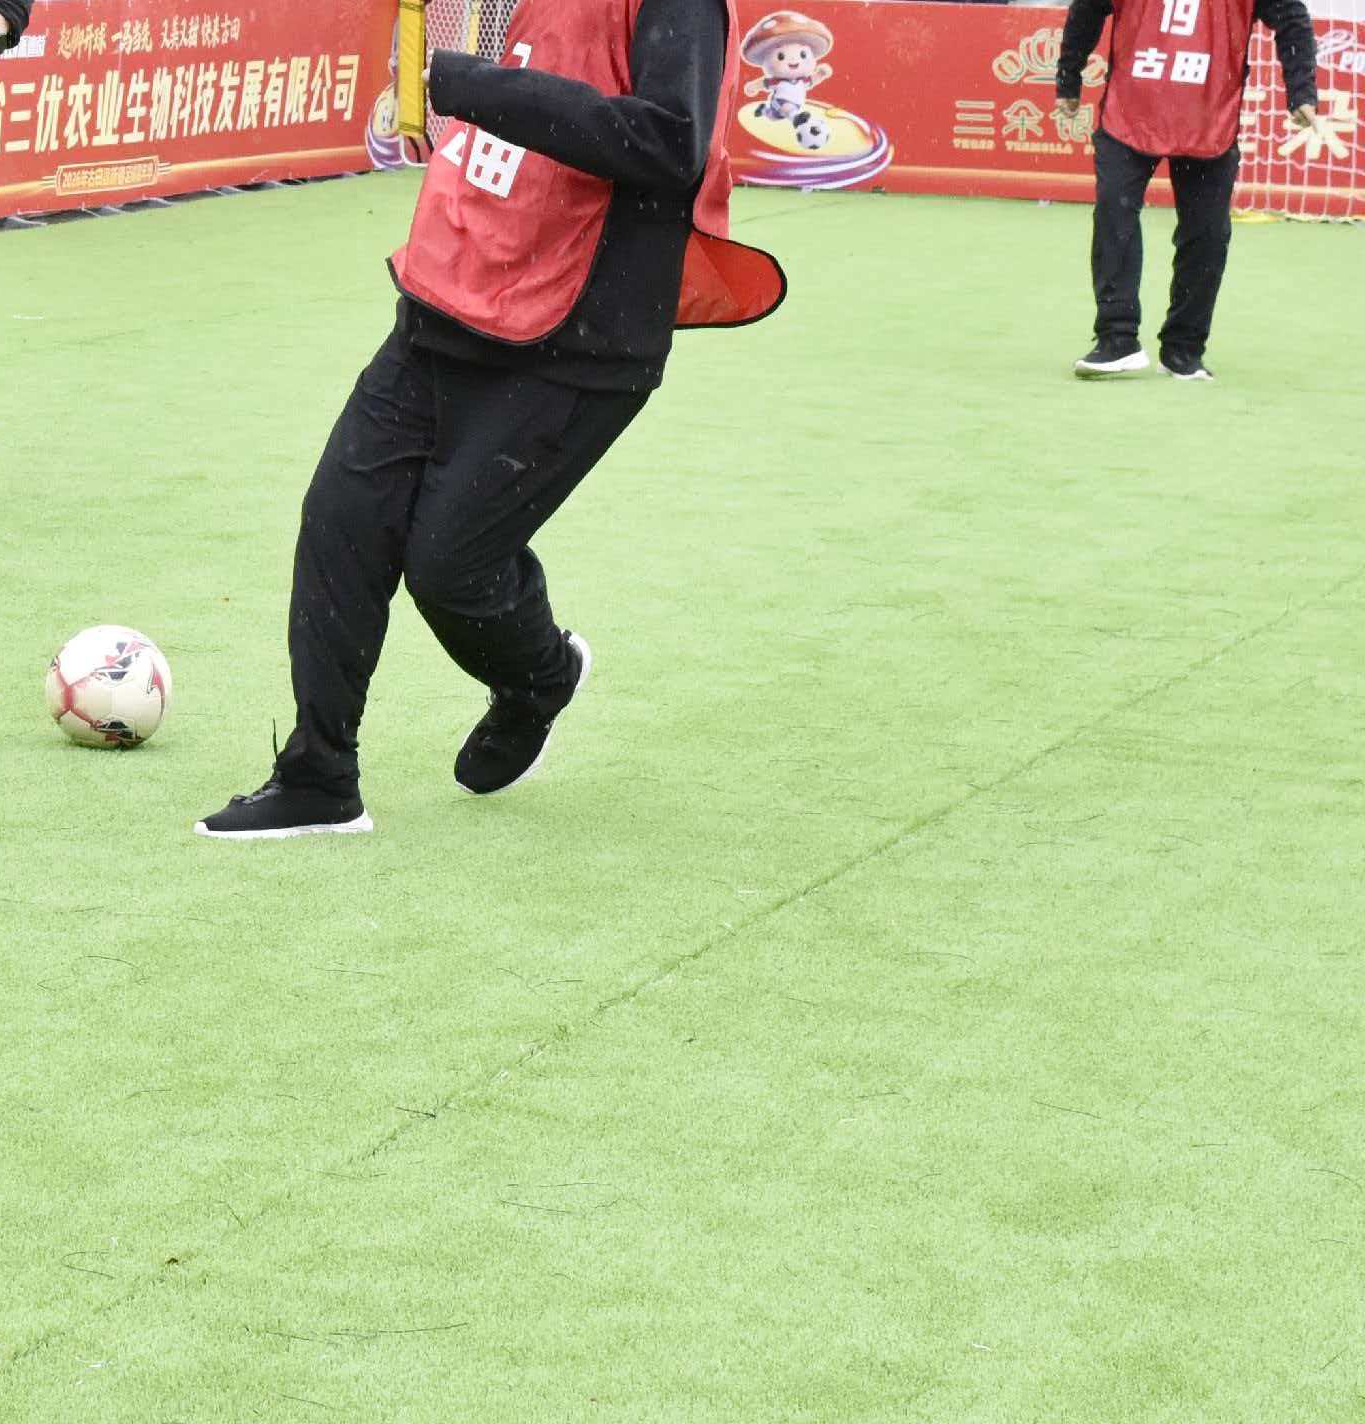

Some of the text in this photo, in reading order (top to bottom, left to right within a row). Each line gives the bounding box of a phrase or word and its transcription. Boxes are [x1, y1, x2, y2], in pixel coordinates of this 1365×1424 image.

[57, 21, 107, 61] 起脚开球
[1131, 47, 1211, 84] 古田
